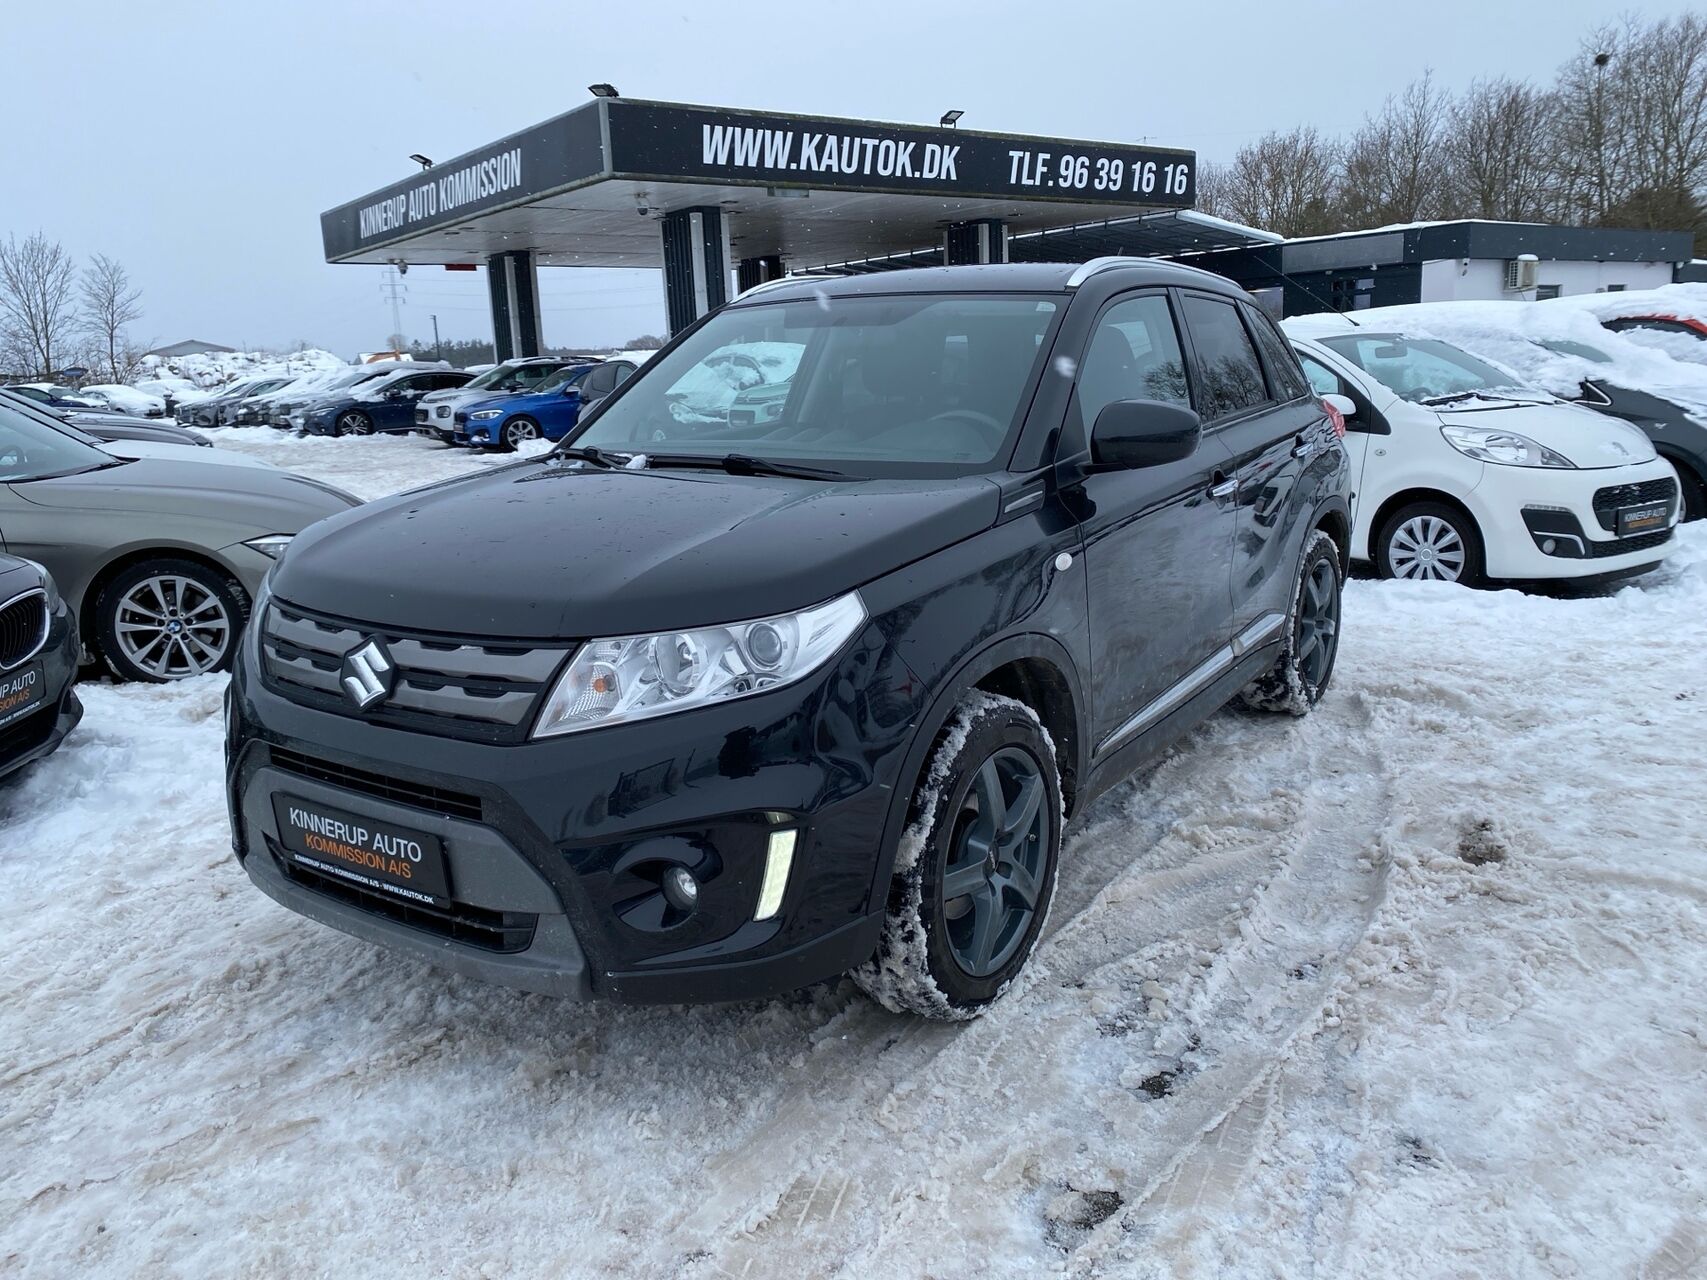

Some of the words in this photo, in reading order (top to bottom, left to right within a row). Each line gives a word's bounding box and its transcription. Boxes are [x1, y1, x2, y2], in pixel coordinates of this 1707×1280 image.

[702, 124, 960, 181] WWW.KAUTOK.DK
[1009, 151, 1053, 186] TLF.
[1058, 155, 1090, 189] 96
[1094, 158, 1124, 191] 39
[1132, 161, 1157, 193] 16
[1164, 164, 1188, 195] 16
[360, 194, 407, 239] KINNERUP
[408, 182, 436, 223] AUTO
[439, 148, 521, 212] KOMMISSION
[10, 671, 36, 695] AUTO
[290, 807, 368, 846] KINNERUP
[372, 833, 422, 863] AUTO
[304, 833, 386, 872] KOMMISSION
[388, 858, 412, 879] A/S
